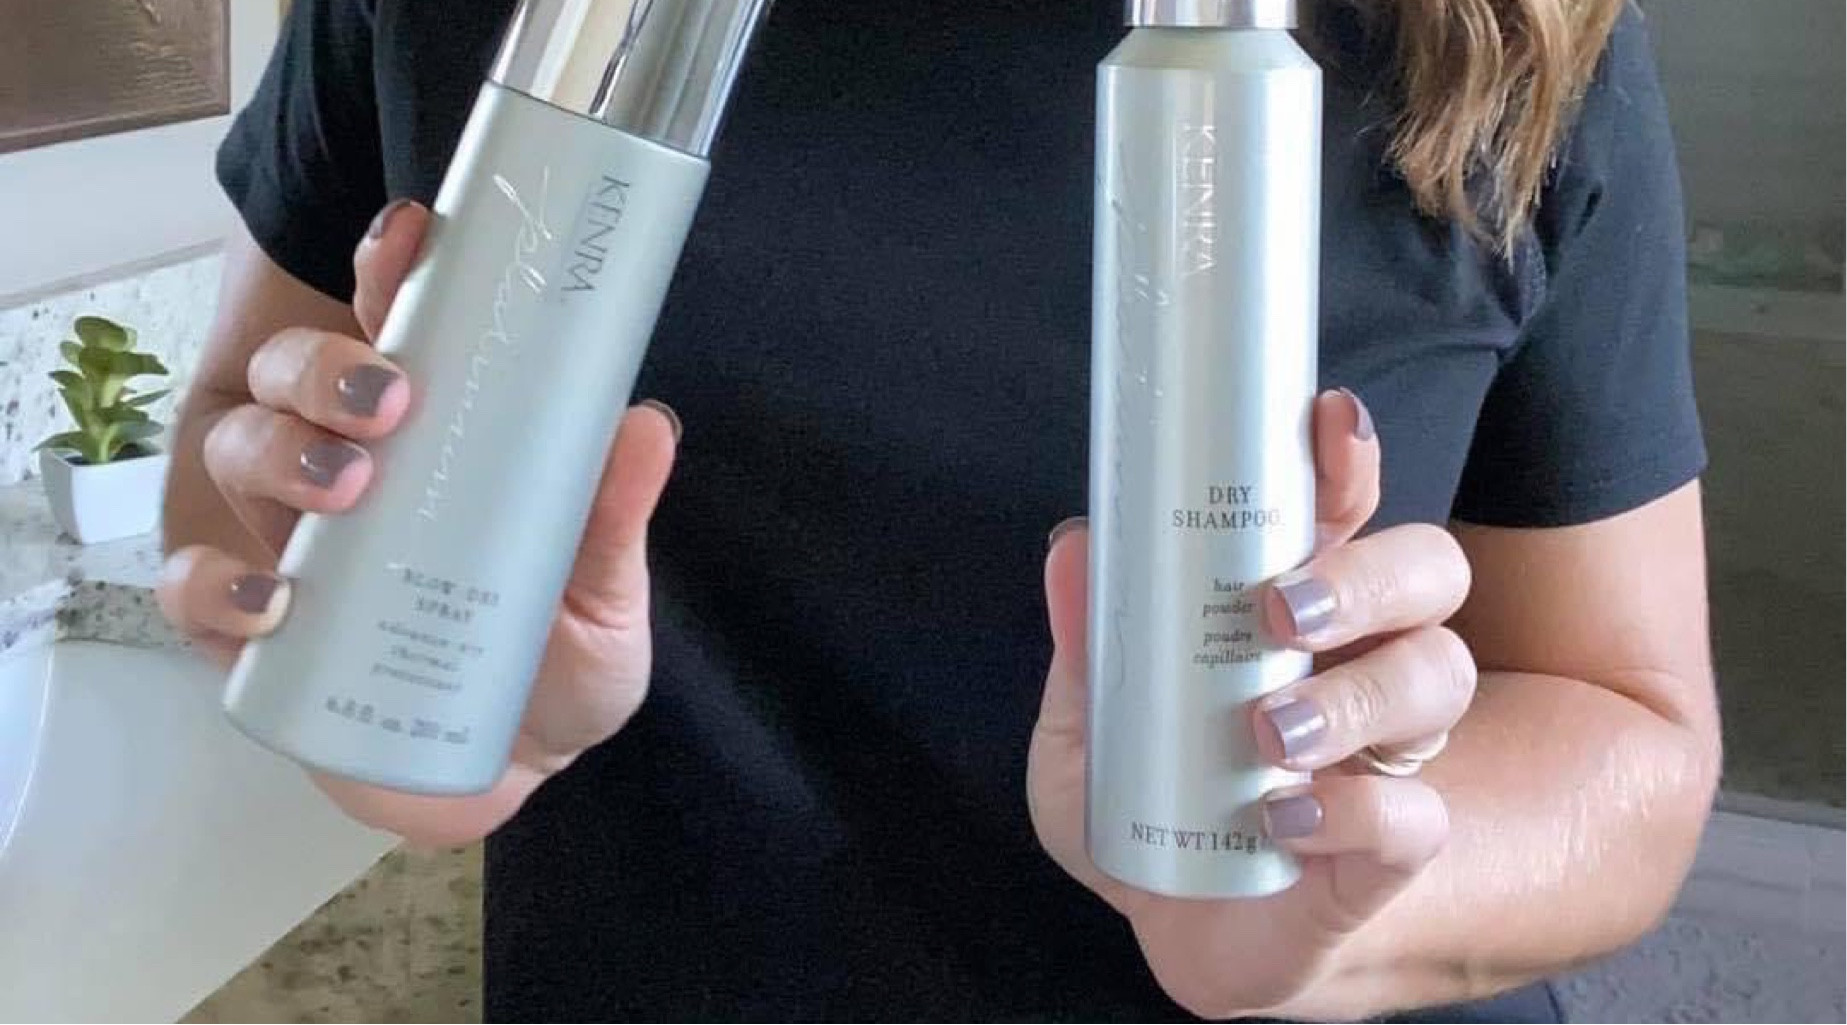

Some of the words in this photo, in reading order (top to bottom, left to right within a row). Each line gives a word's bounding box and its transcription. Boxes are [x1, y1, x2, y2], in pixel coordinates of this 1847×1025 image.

[561, 175, 631, 295] KENRA
[1209, 485, 1253, 505] DRY
[1172, 509, 1282, 529] SHAMPOO
[1213, 578, 1245, 593] hair
[1203, 600, 1255, 617] powder
[1131, 821, 1168, 846] NET
[1173, 830, 1206, 851] WT
